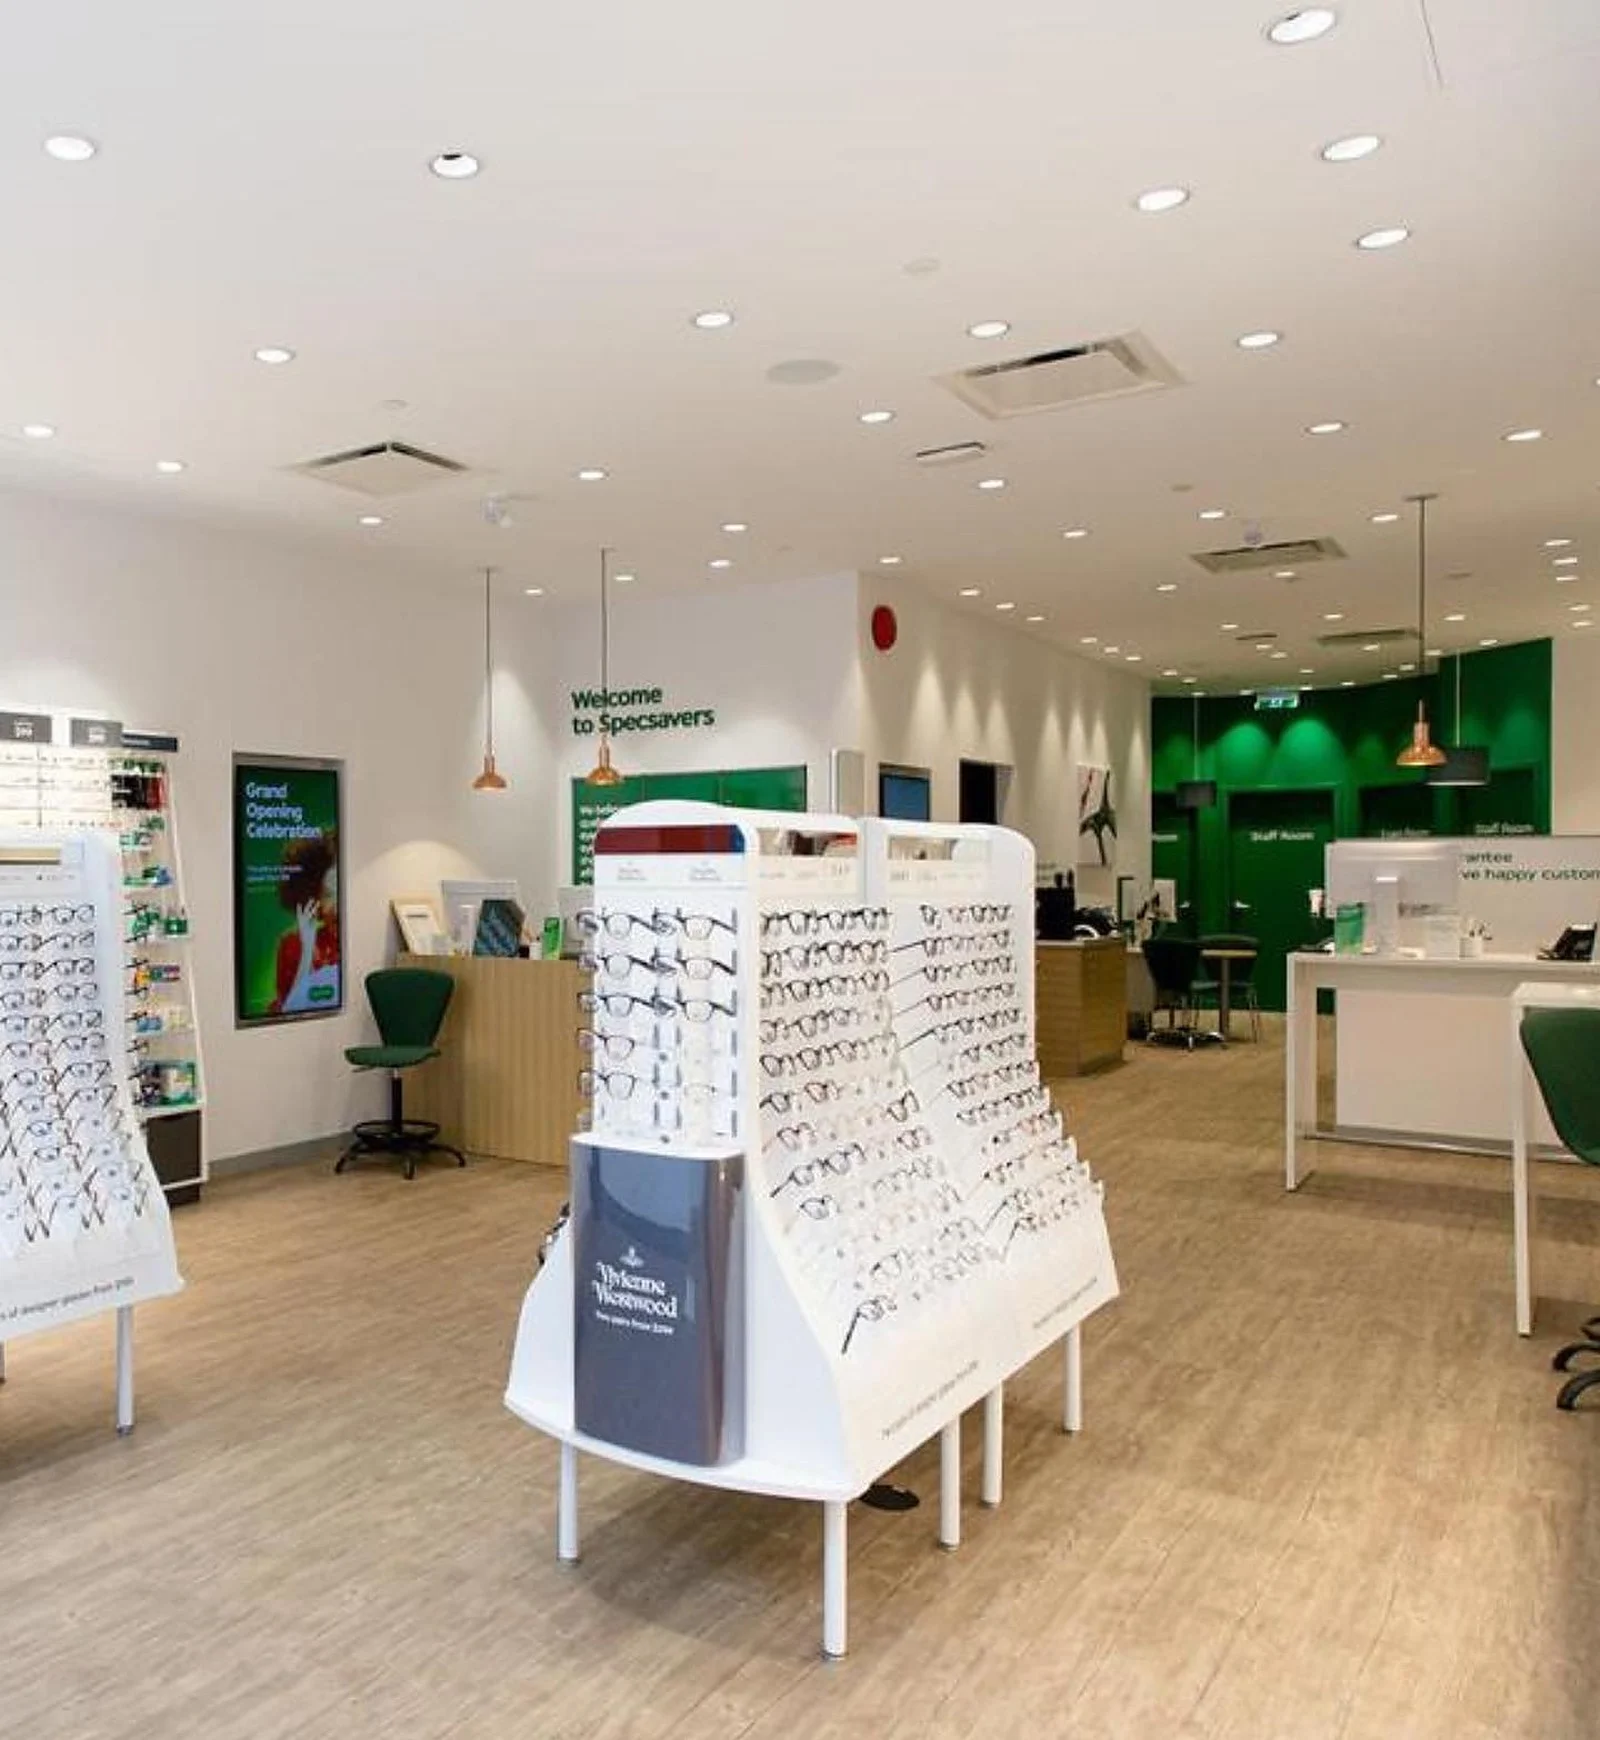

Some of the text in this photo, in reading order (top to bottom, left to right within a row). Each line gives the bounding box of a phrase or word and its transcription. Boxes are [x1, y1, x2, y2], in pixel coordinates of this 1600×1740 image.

[571, 687, 663, 709] Welcome
[572, 709, 715, 736] to Specsavers
[246, 782, 288, 799] Grand
[246, 802, 303, 823] Opening
[246, 822, 322, 838] Celebration
[1485, 868, 1537, 883] happy
[591, 1280, 677, 1318] Westwood
